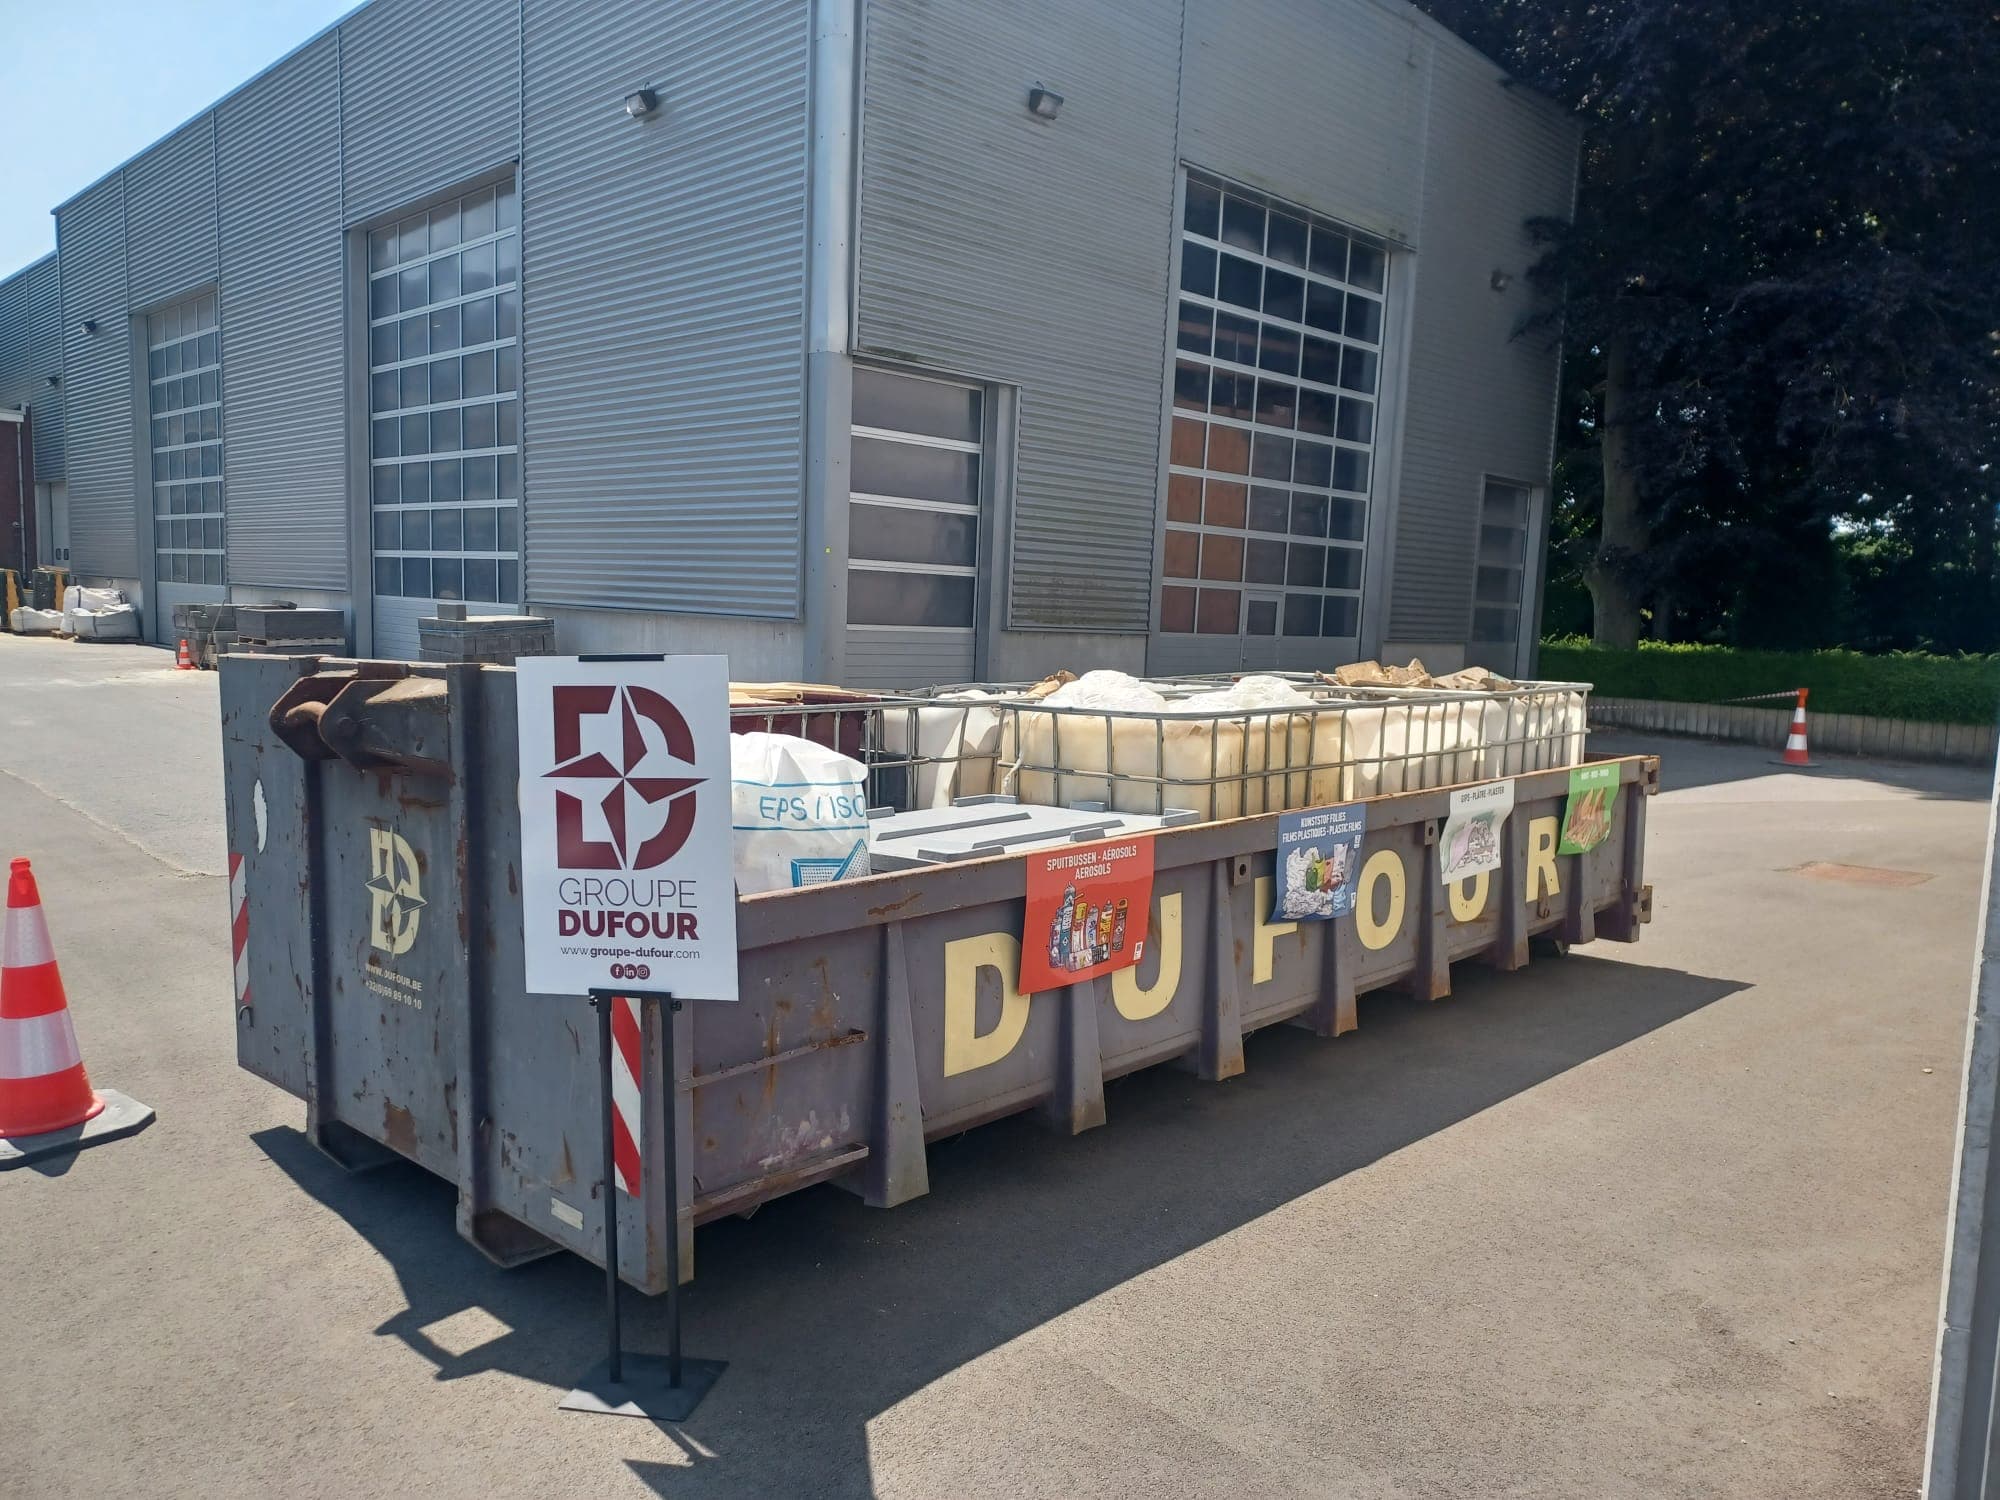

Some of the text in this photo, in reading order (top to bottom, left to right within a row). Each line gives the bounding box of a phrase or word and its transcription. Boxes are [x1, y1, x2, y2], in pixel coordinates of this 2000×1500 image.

[759, 796, 807, 821] EPS
[830, 794, 866, 819] ISO
[1301, 812, 1346, 828] KUNSTSTOF FOLIES
[1282, 832, 1297, 843] FILMS
[1298, 827, 1326, 841] PLASTIQUES
[1329, 824, 1348, 835] PLASTIC
[1348, 821, 1362, 832] FILMS
[1047, 851, 1097, 872] SPUITBUSSEN
[1102, 845, 1137, 861] AÉROSOLS
[1075, 863, 1111, 880] AEROSOLS
[559, 877, 698, 908] GROUPE
[558, 909, 700, 940] DUFOUR
[560, 946, 701, 960] www.groupe-dufour.com
[413, 998, 422, 1010] 10
